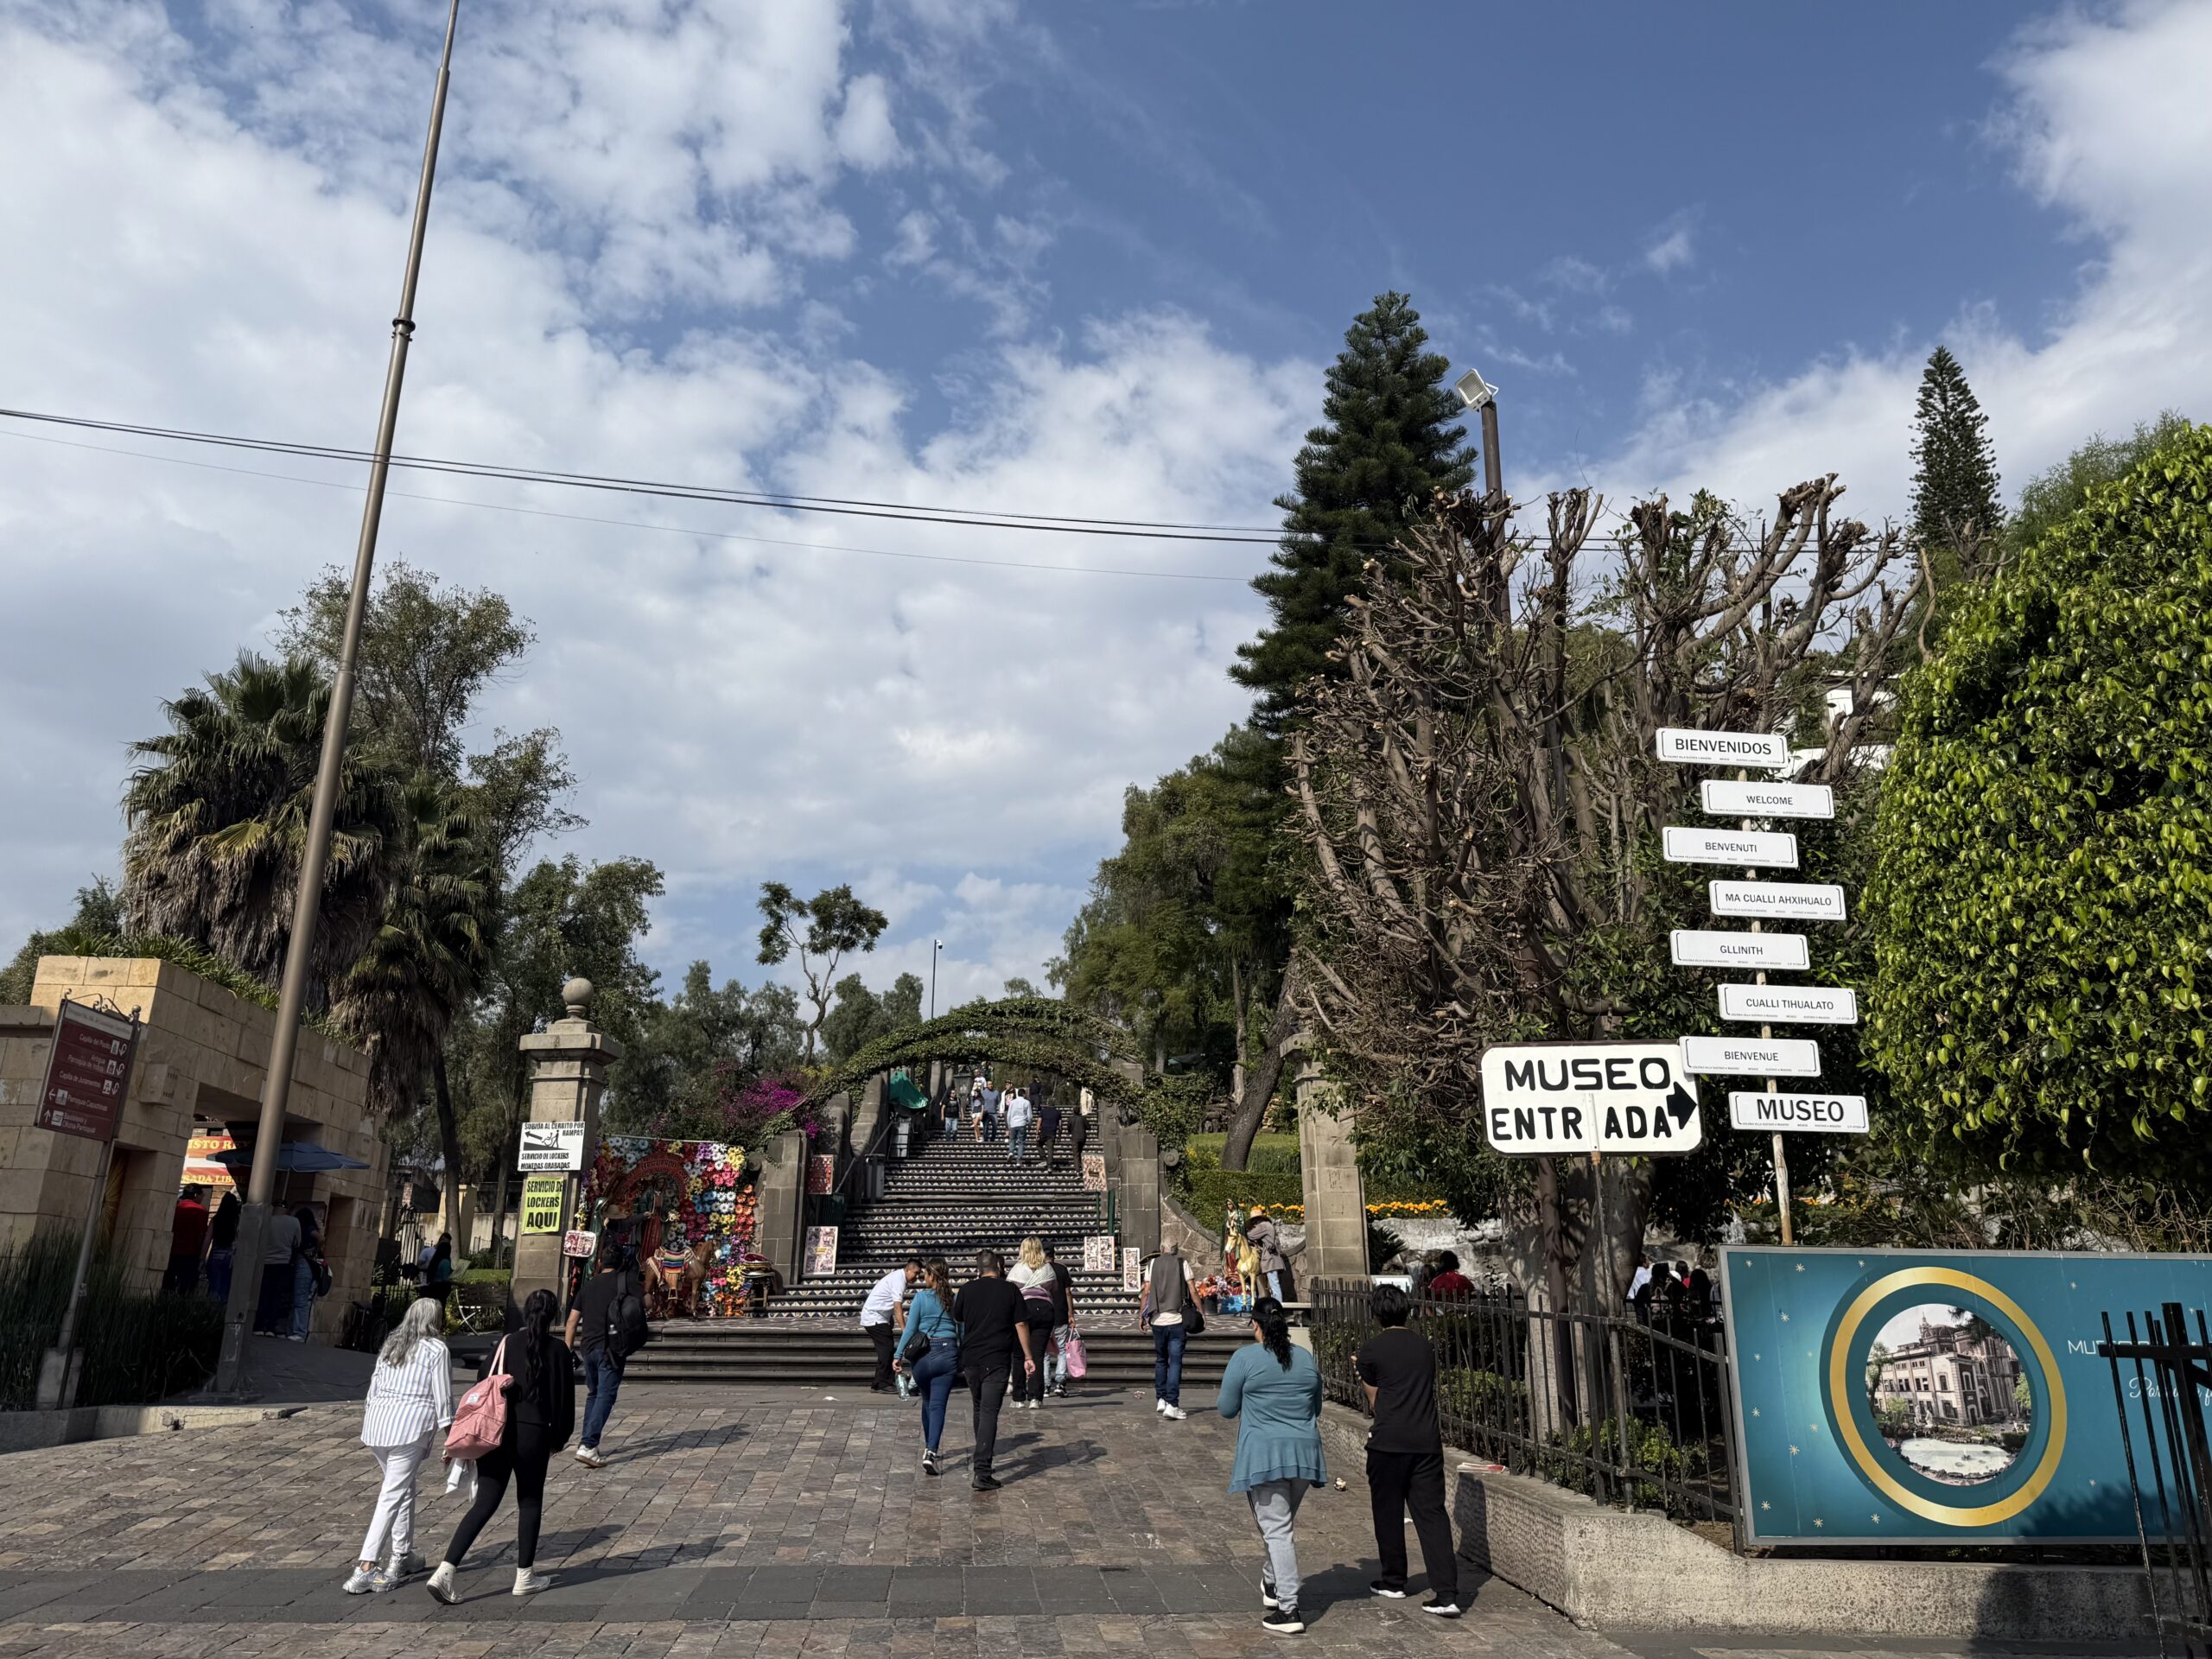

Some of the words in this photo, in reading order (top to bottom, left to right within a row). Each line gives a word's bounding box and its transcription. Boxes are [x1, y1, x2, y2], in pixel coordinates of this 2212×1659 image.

[1675, 738, 1771, 755] BIENVENIDOS
[1746, 795, 1793, 805] WELCOME
[1705, 842, 1758, 852] BENVENUTI
[1725, 893, 1741, 902] MA
[1743, 893, 1776, 904] CUALLI
[1778, 895, 1832, 906] AHXIHUALO
[1719, 945, 1764, 955] GLLINITH
[1745, 998, 1779, 1008] CUALLI
[1782, 1000, 1834, 1010] TIHUALATO
[1724, 1051, 1778, 1061] BIENVENUE
[1504, 1058, 1671, 1091] MUSEO
[1757, 1098, 1845, 1122] MUSEO
[527, 1181, 555, 1192] SERVICIO
[556, 1181, 563, 1192] DE
[527, 1197, 560, 1208] LOCKERS
[526, 1212, 557, 1229] AQUI
